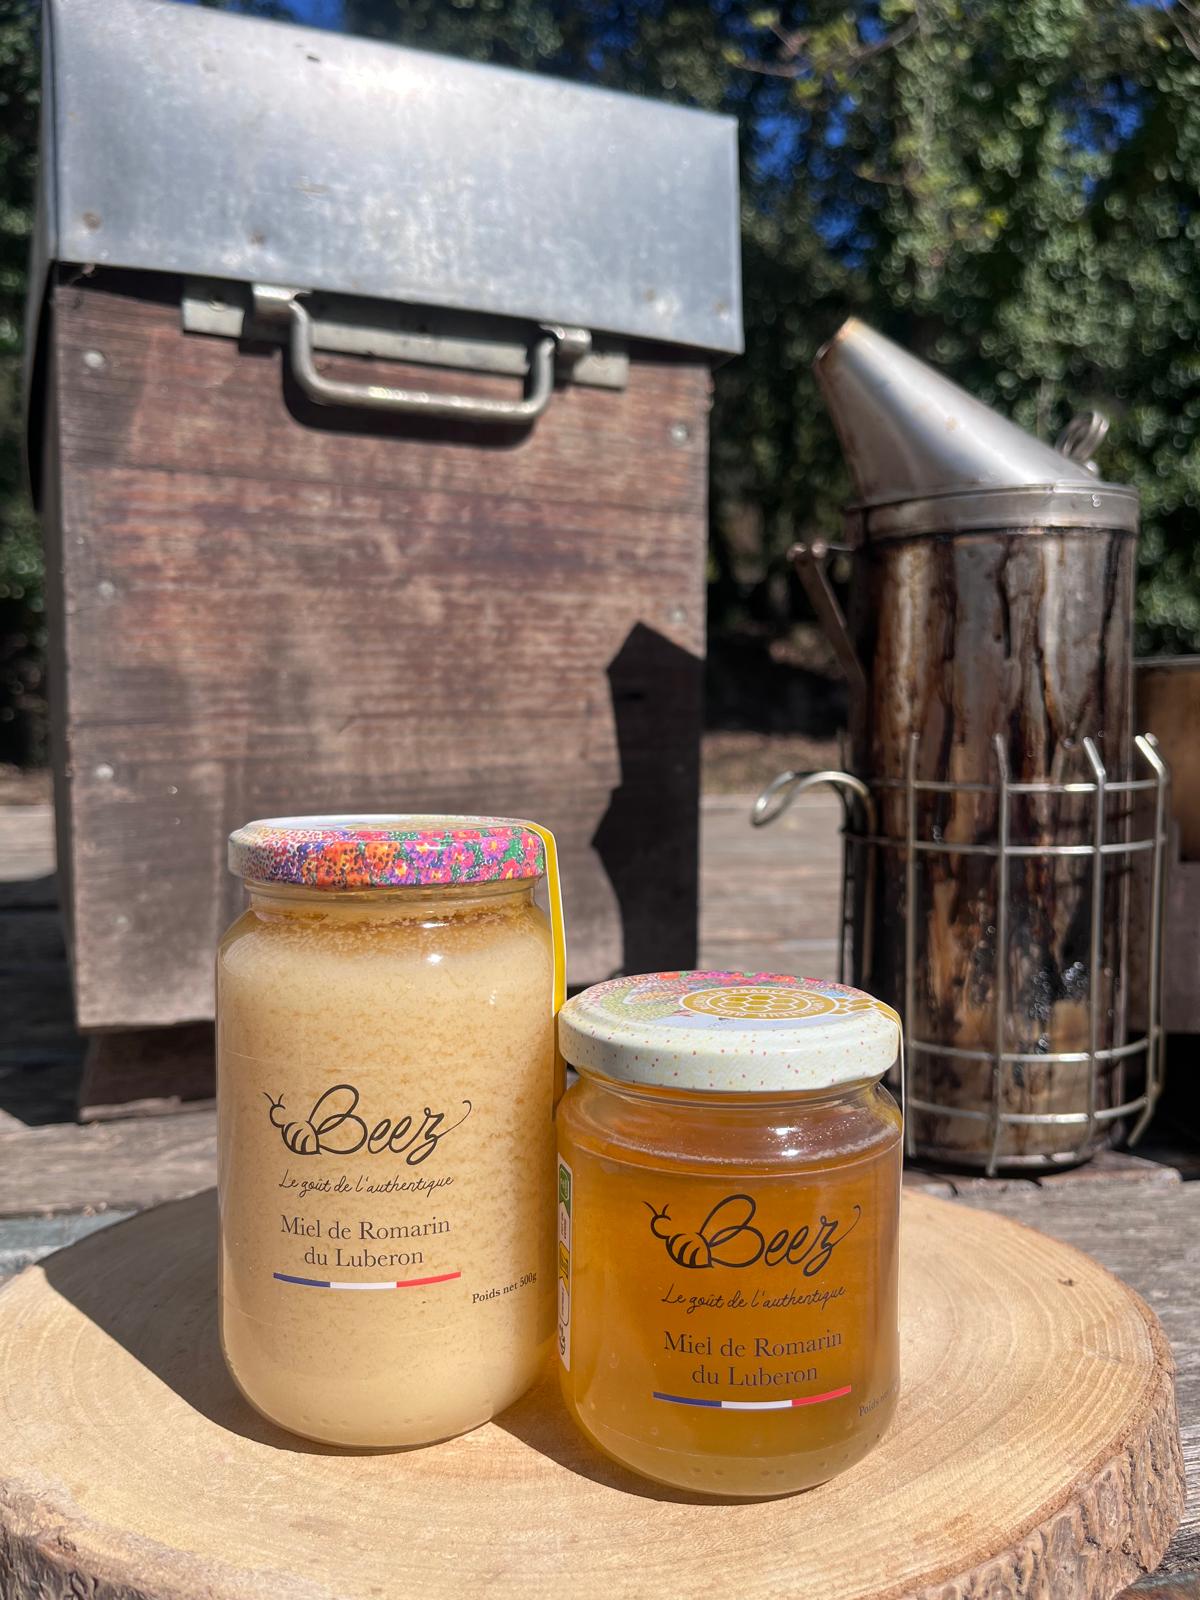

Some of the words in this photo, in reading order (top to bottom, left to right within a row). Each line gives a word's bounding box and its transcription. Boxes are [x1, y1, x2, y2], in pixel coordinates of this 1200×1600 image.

[306, 1083, 472, 1166] Beez
[278, 1169, 300, 1189] Le
[299, 1178, 333, 1198] goût
[333, 1175, 353, 1193] de
[355, 1174, 455, 1198] l'authentique
[280, 1214, 322, 1238] Miel
[327, 1219, 352, 1240] de
[358, 1215, 451, 1241] Romarin
[699, 1193, 862, 1277] Beez
[303, 1246, 329, 1267] du
[334, 1248, 425, 1268] Luberon
[471, 1288, 502, 1304] Poids
[502, 1281, 520, 1294] net
[519, 1271, 538, 1288] 500g
[660, 1283, 687, 1305] Le
[686, 1296, 724, 1315] goût
[726, 1290, 748, 1309] de
[750, 1285, 848, 1312] l'authentique
[663, 1330, 712, 1356] Miel
[719, 1337, 746, 1358] de
[754, 1328, 843, 1358] Romarin
[691, 1364, 720, 1386] du
[727, 1366, 818, 1387] Luberon
